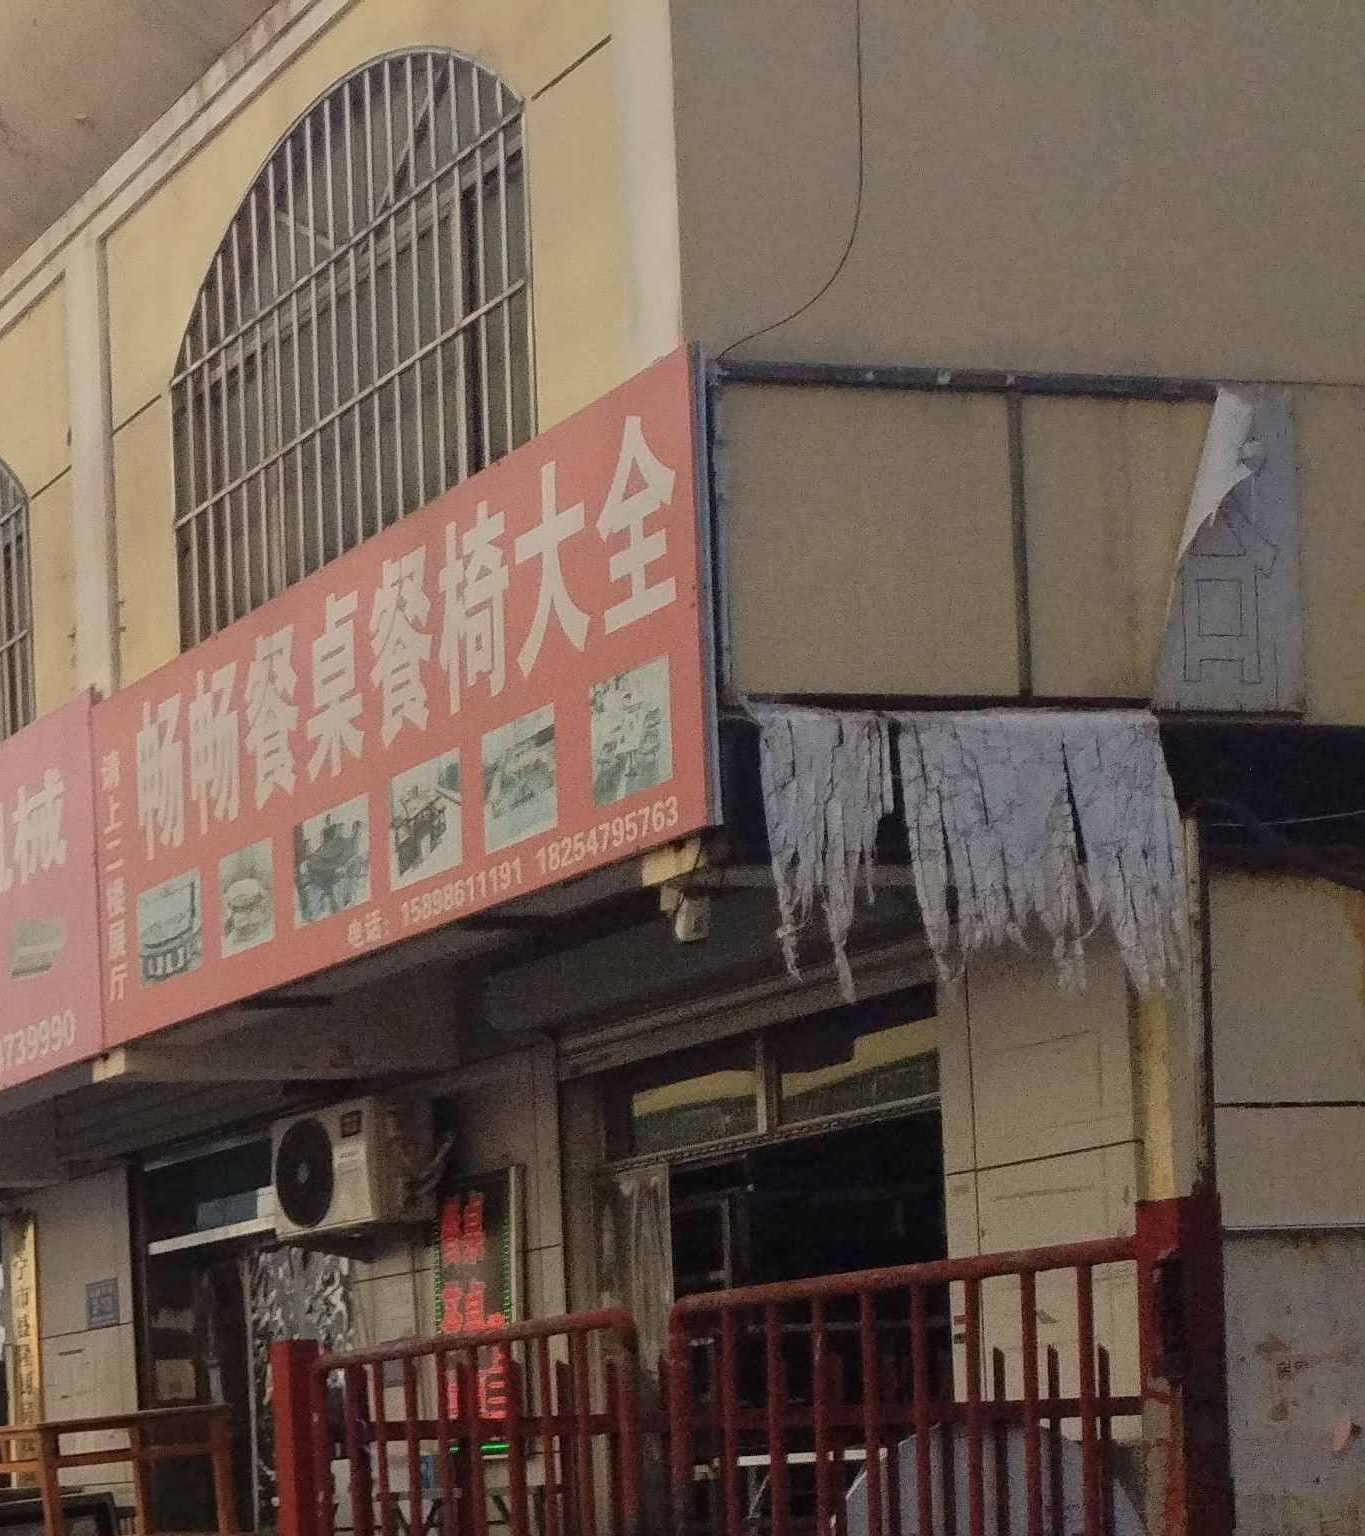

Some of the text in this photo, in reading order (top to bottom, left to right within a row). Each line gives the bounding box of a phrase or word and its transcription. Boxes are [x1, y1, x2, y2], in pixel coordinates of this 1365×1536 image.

[137, 415, 677, 860] 畅畅餐桌餐椅大全
[537, 796, 679, 874] 18254795763
